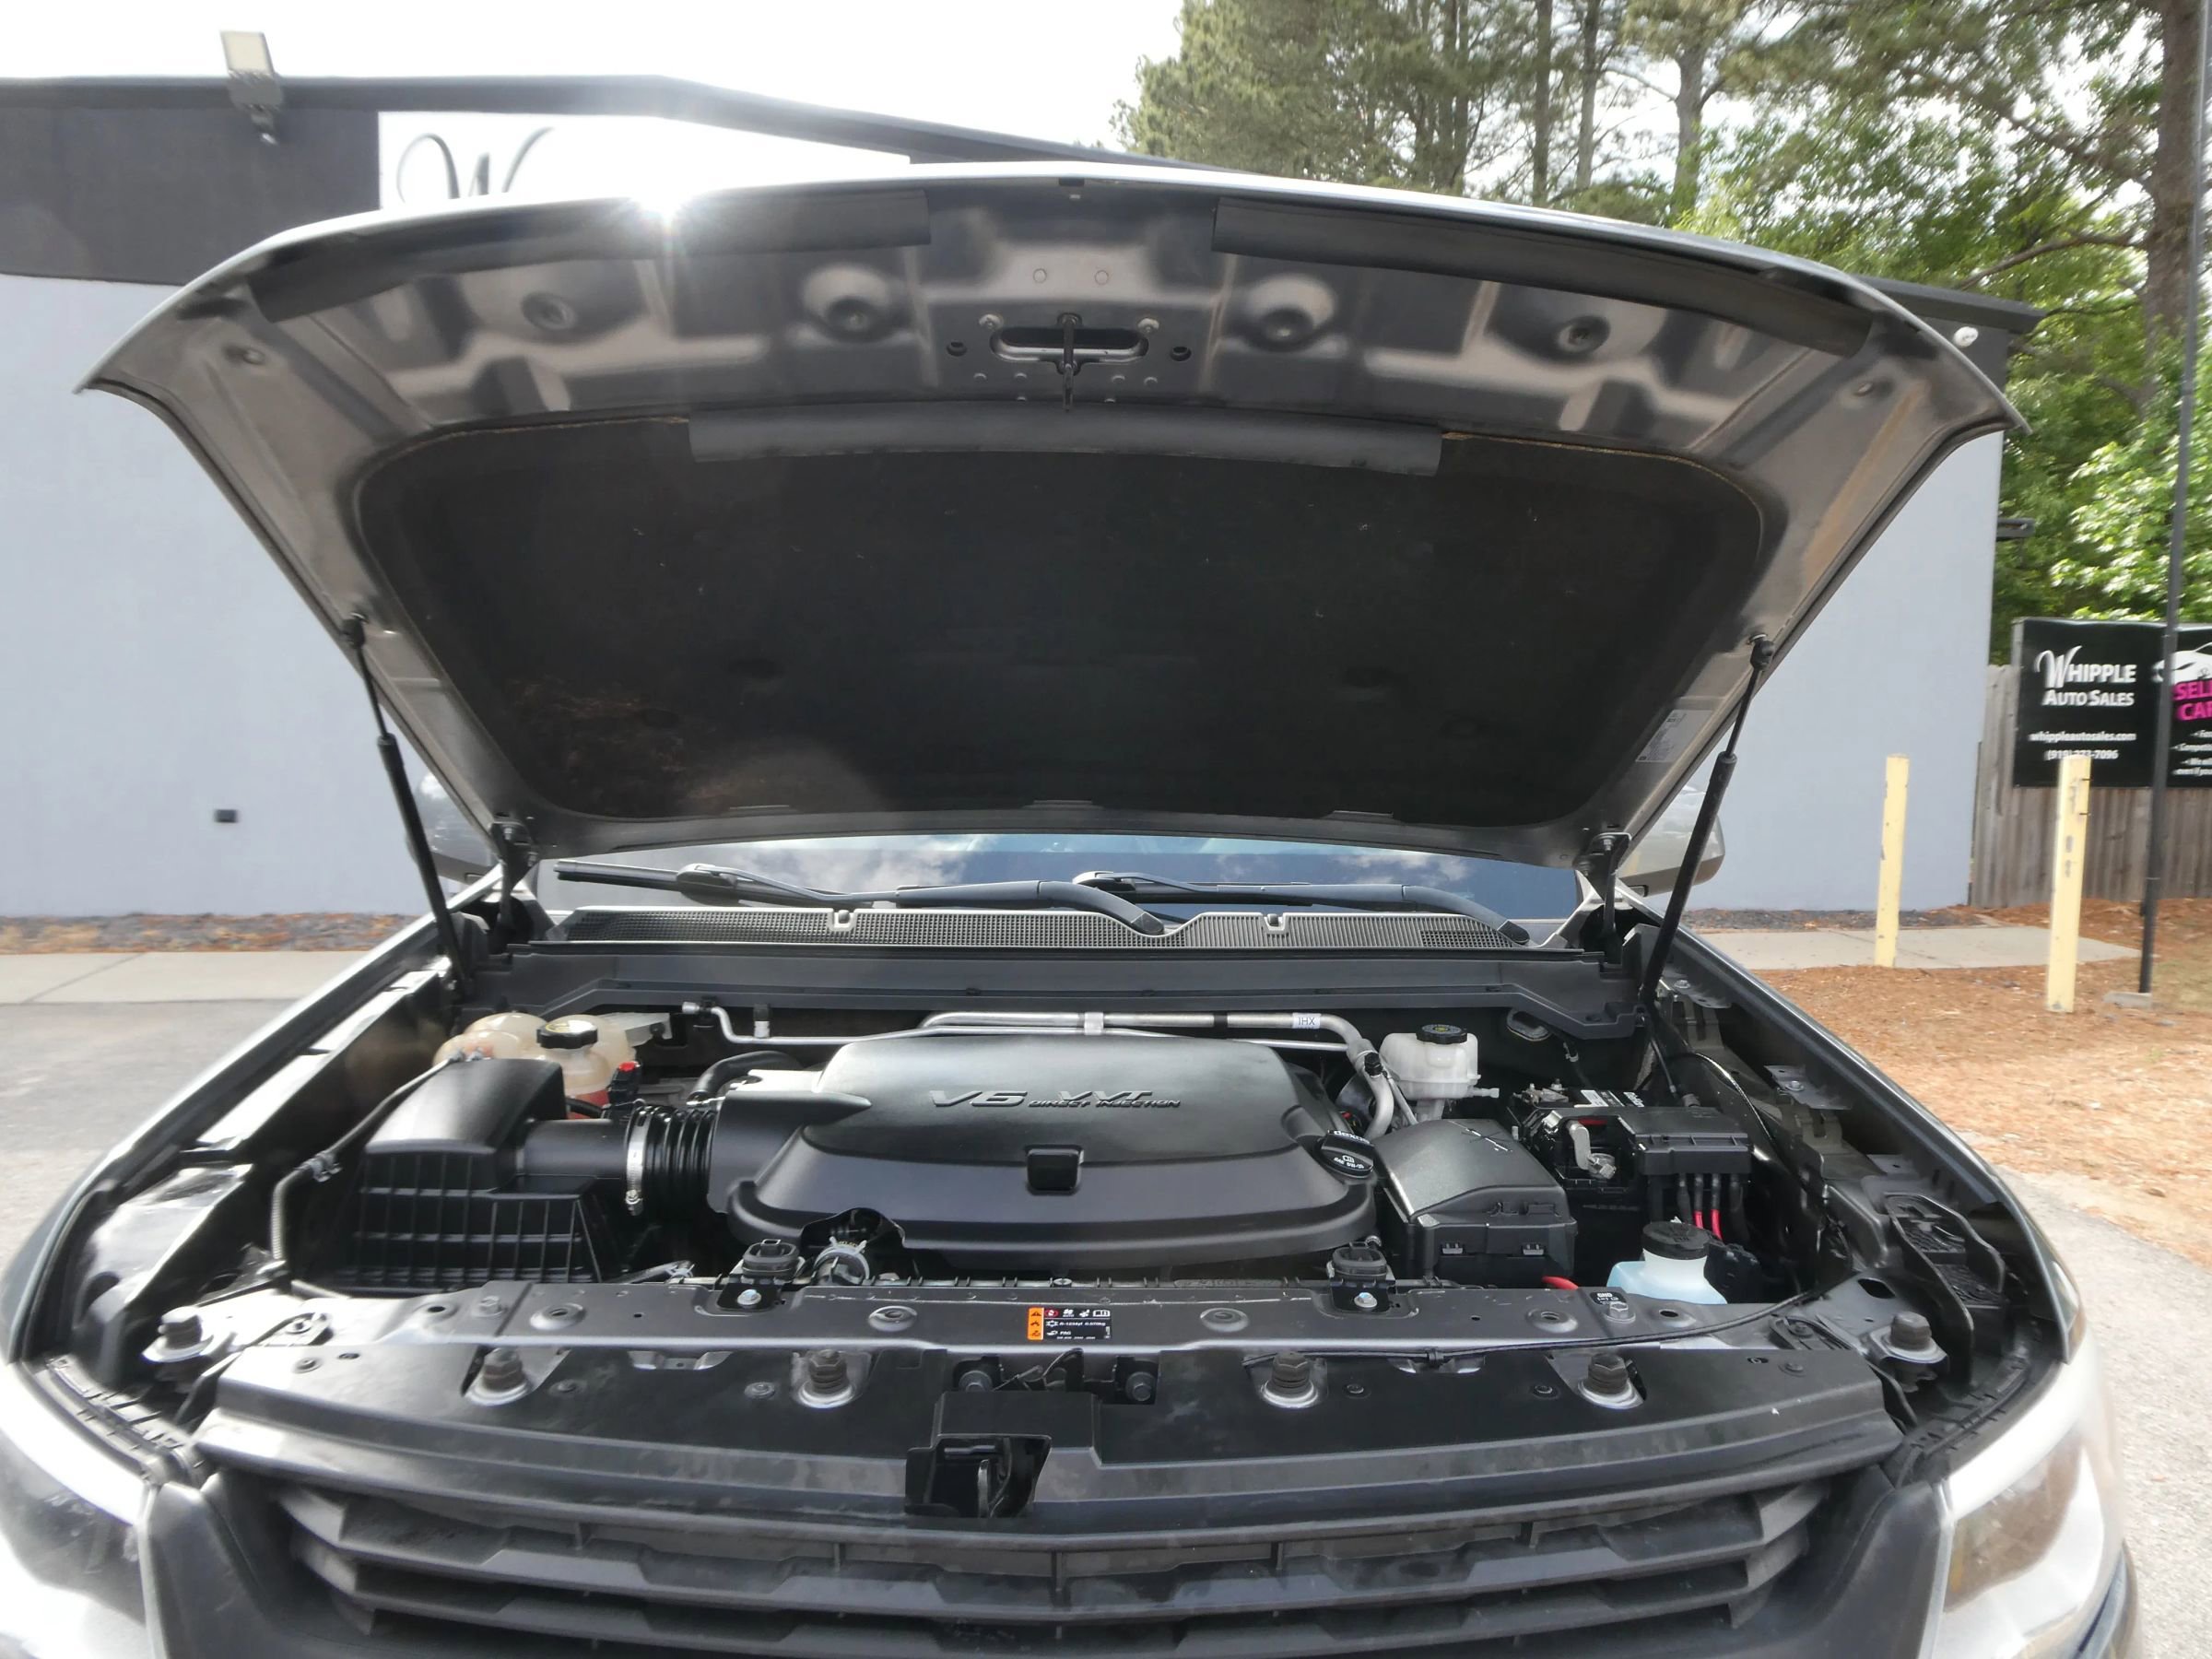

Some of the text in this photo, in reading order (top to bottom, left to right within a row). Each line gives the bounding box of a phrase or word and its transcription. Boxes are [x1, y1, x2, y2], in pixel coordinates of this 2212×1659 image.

[2041, 689, 2136, 706] AUTO SALES
[929, 1090, 1152, 1107] V6 VVT
